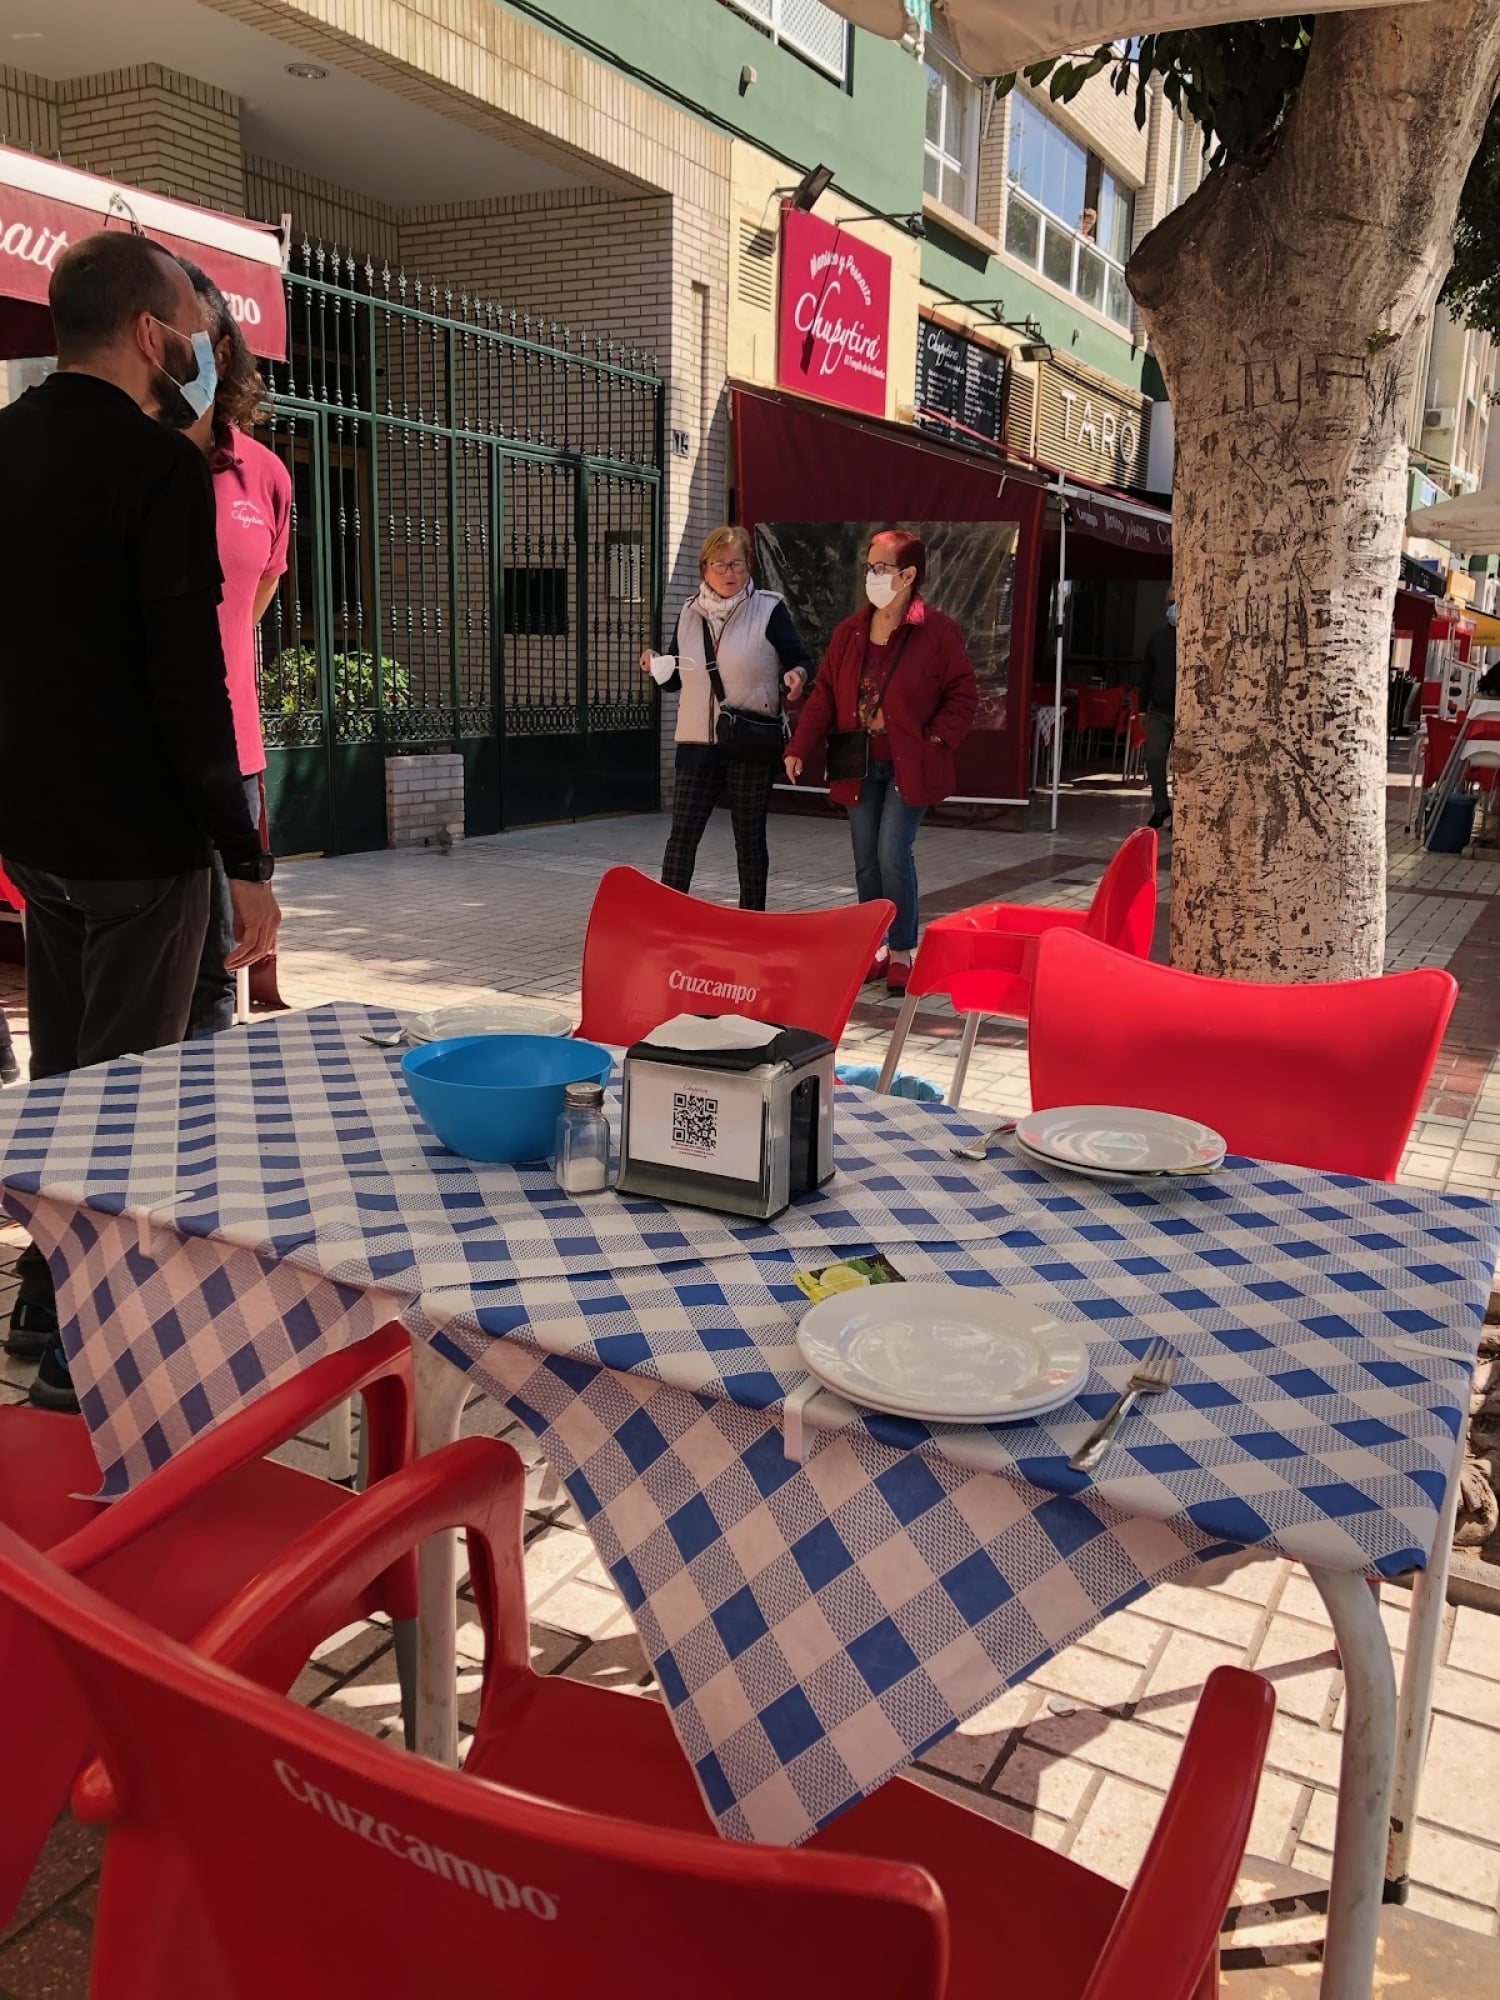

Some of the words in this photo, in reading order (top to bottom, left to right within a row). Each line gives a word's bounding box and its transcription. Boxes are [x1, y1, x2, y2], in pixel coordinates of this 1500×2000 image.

[0, 218, 69, 272] ait
[669, 969, 758, 1004] Cruzcampo
[272, 1758, 559, 1921] Cruzcampo
